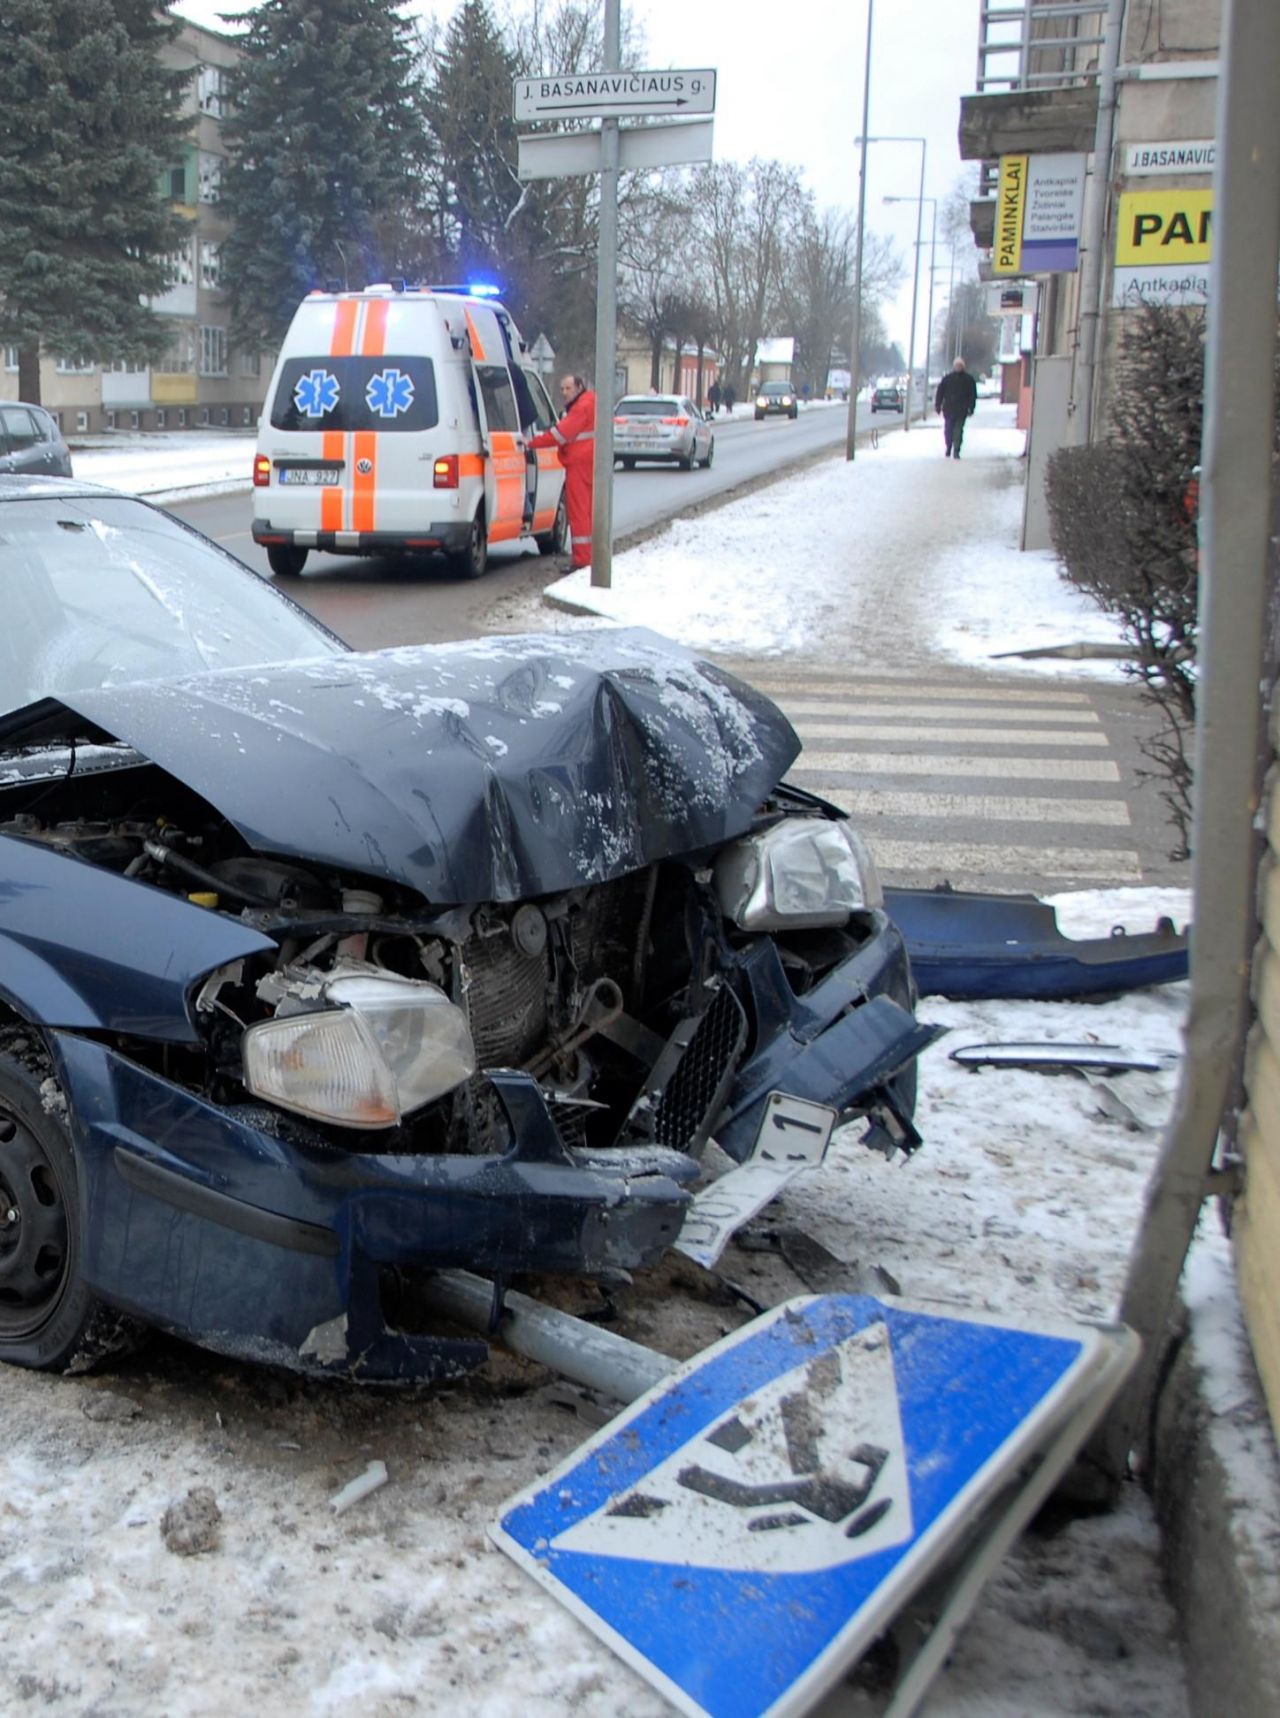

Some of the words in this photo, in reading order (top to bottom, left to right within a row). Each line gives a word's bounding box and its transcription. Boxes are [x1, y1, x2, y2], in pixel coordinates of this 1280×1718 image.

[523, 85, 533, 99] J.
[541, 74, 684, 98] BASANAVIČIAUS
[690, 78, 706, 95] g.
[1000, 163, 1021, 266] PAMINKLAI
[317, 471, 337, 483] 927
